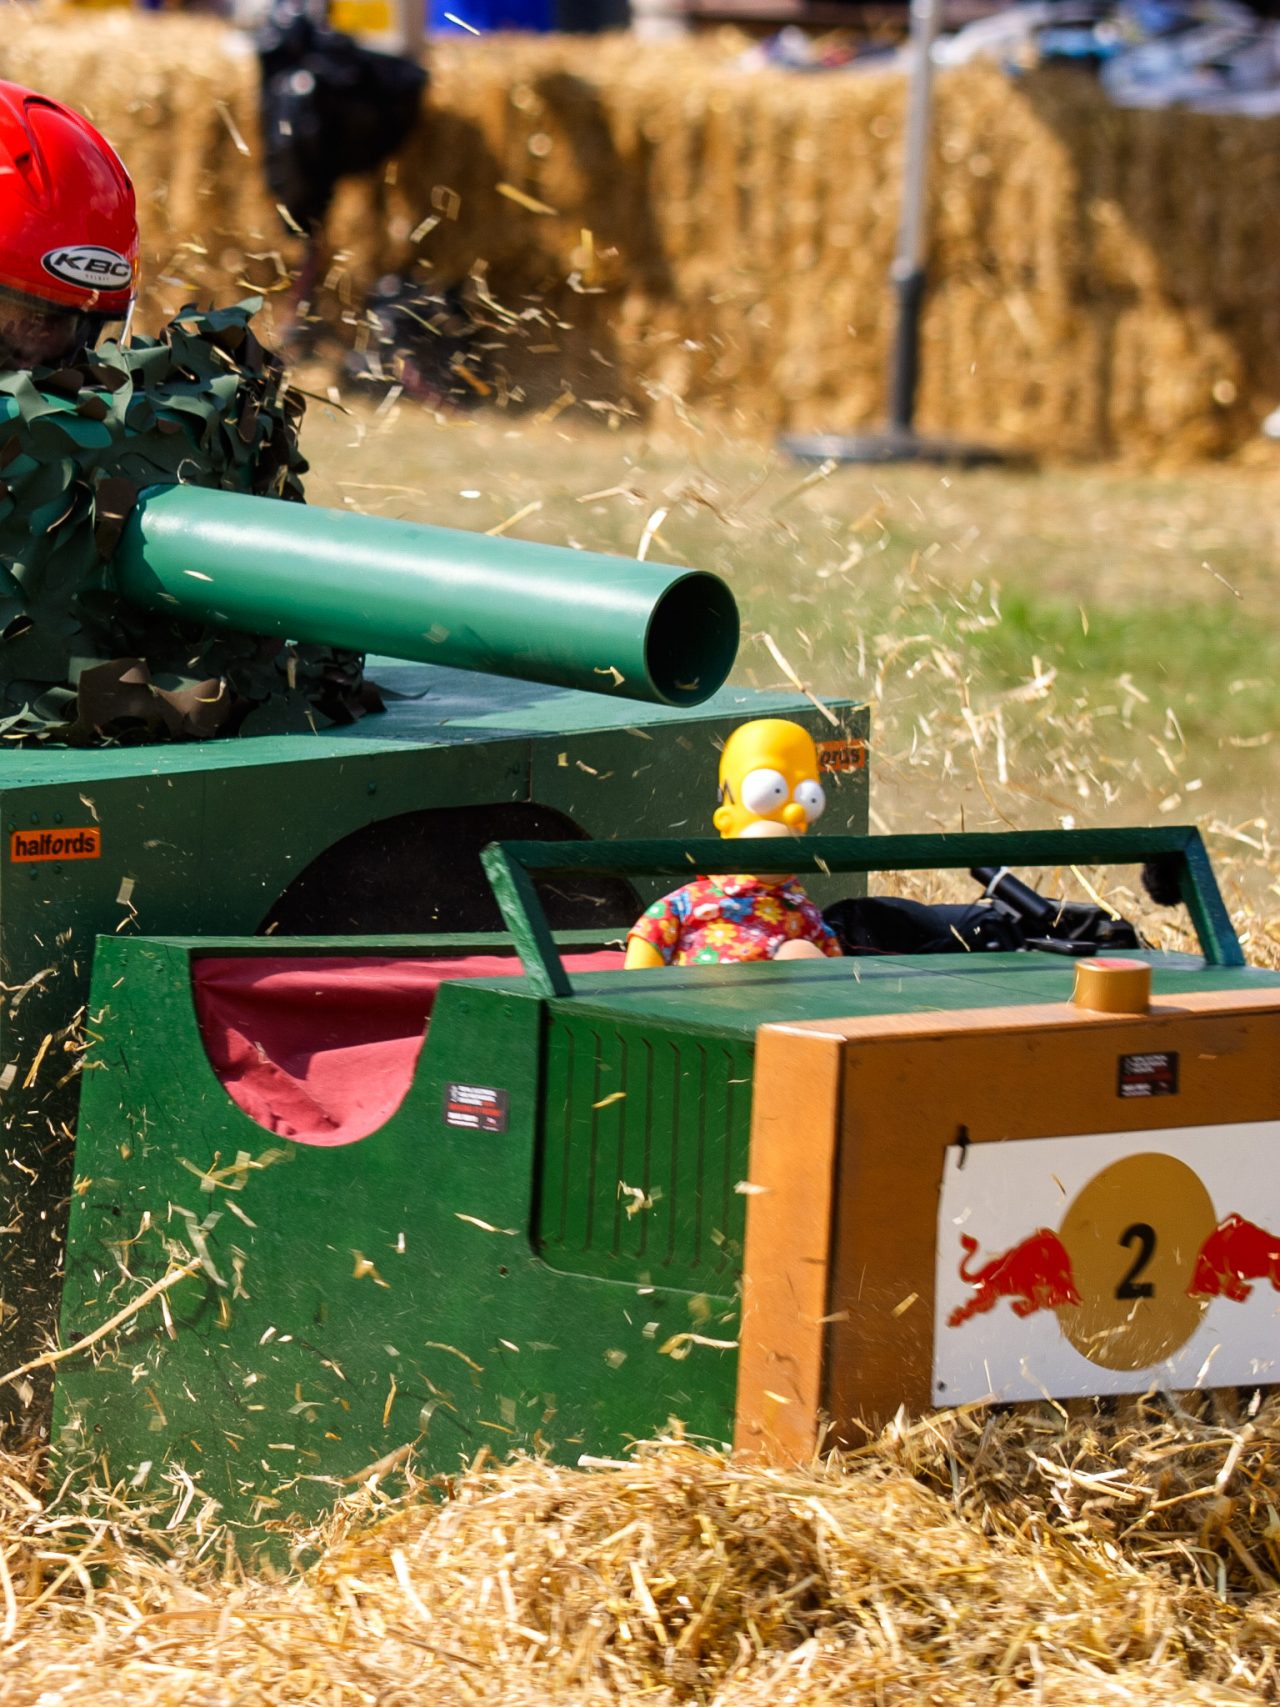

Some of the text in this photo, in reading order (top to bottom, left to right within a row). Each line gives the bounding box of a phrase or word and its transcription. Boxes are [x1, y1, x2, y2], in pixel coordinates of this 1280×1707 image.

[54, 253, 130, 277] KBC
[819, 747, 861, 767] ords
[15, 832, 96, 857] halfords
[1114, 1222, 1158, 1301] 2
